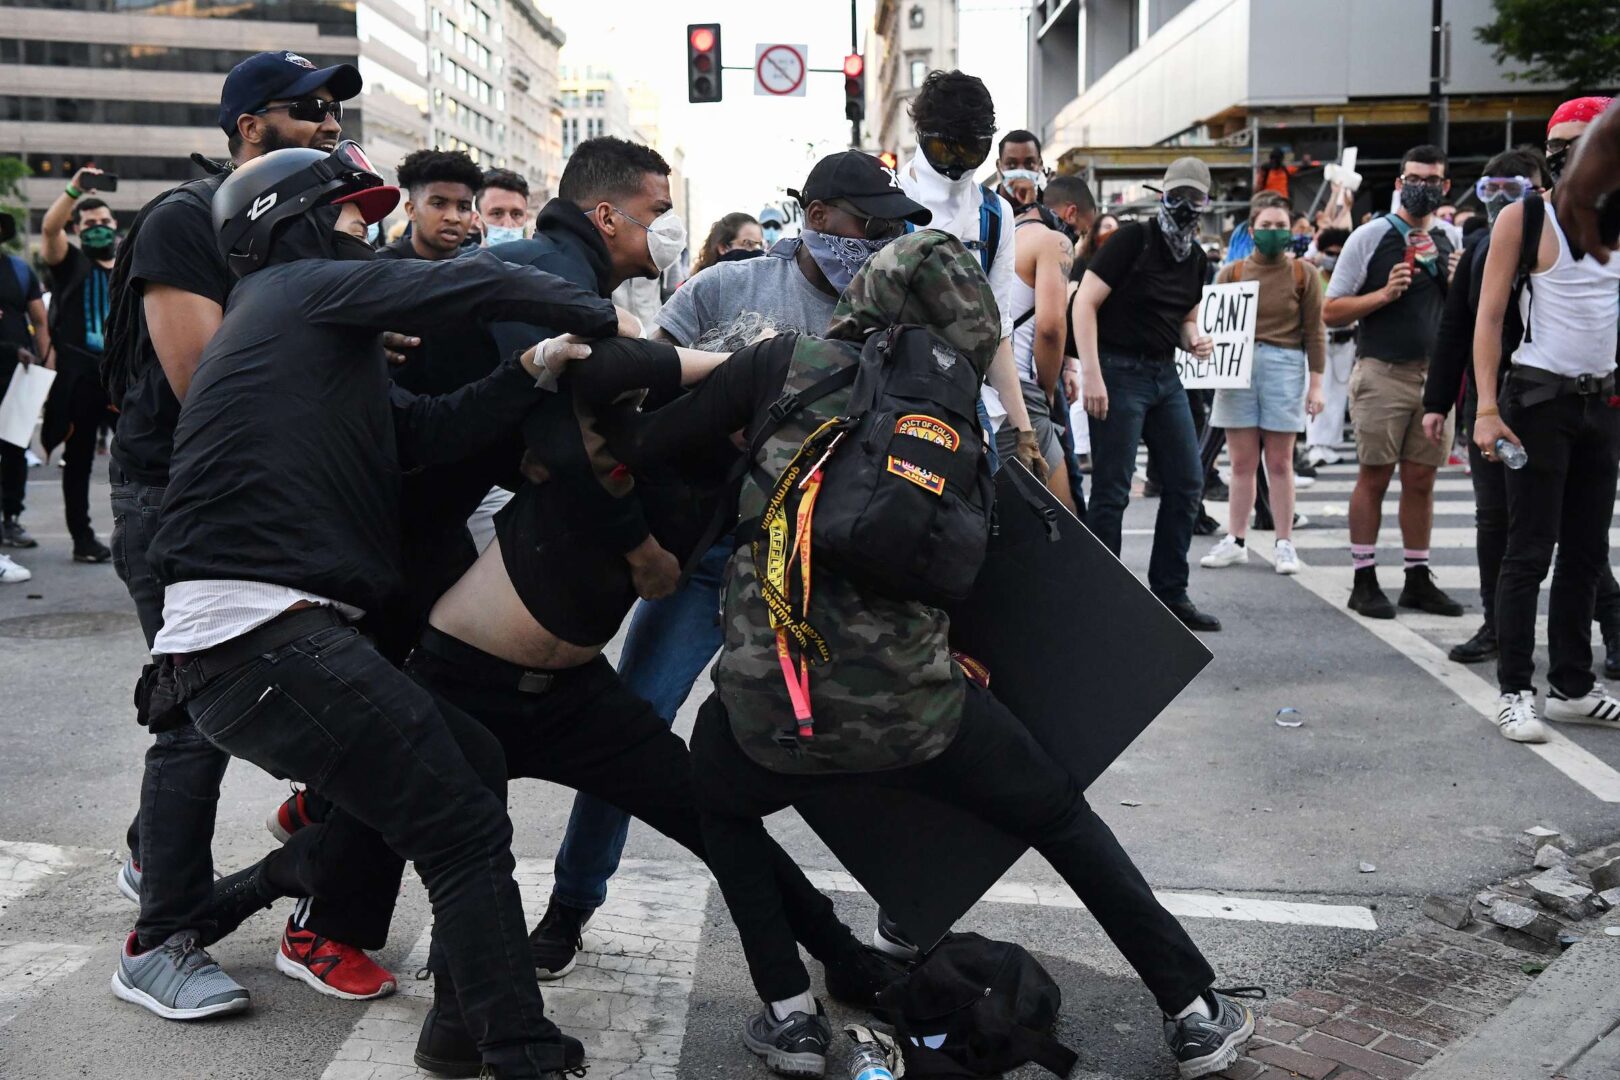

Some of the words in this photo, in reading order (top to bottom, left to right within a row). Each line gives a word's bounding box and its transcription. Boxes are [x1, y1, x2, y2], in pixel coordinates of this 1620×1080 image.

[899, 420, 921, 434] TRICT
[921, 420, 933, 429] OF
[932, 424, 953, 449] COLUM
[761, 466, 800, 530] goarmy.com
[761, 588, 808, 648] goarmy.com
